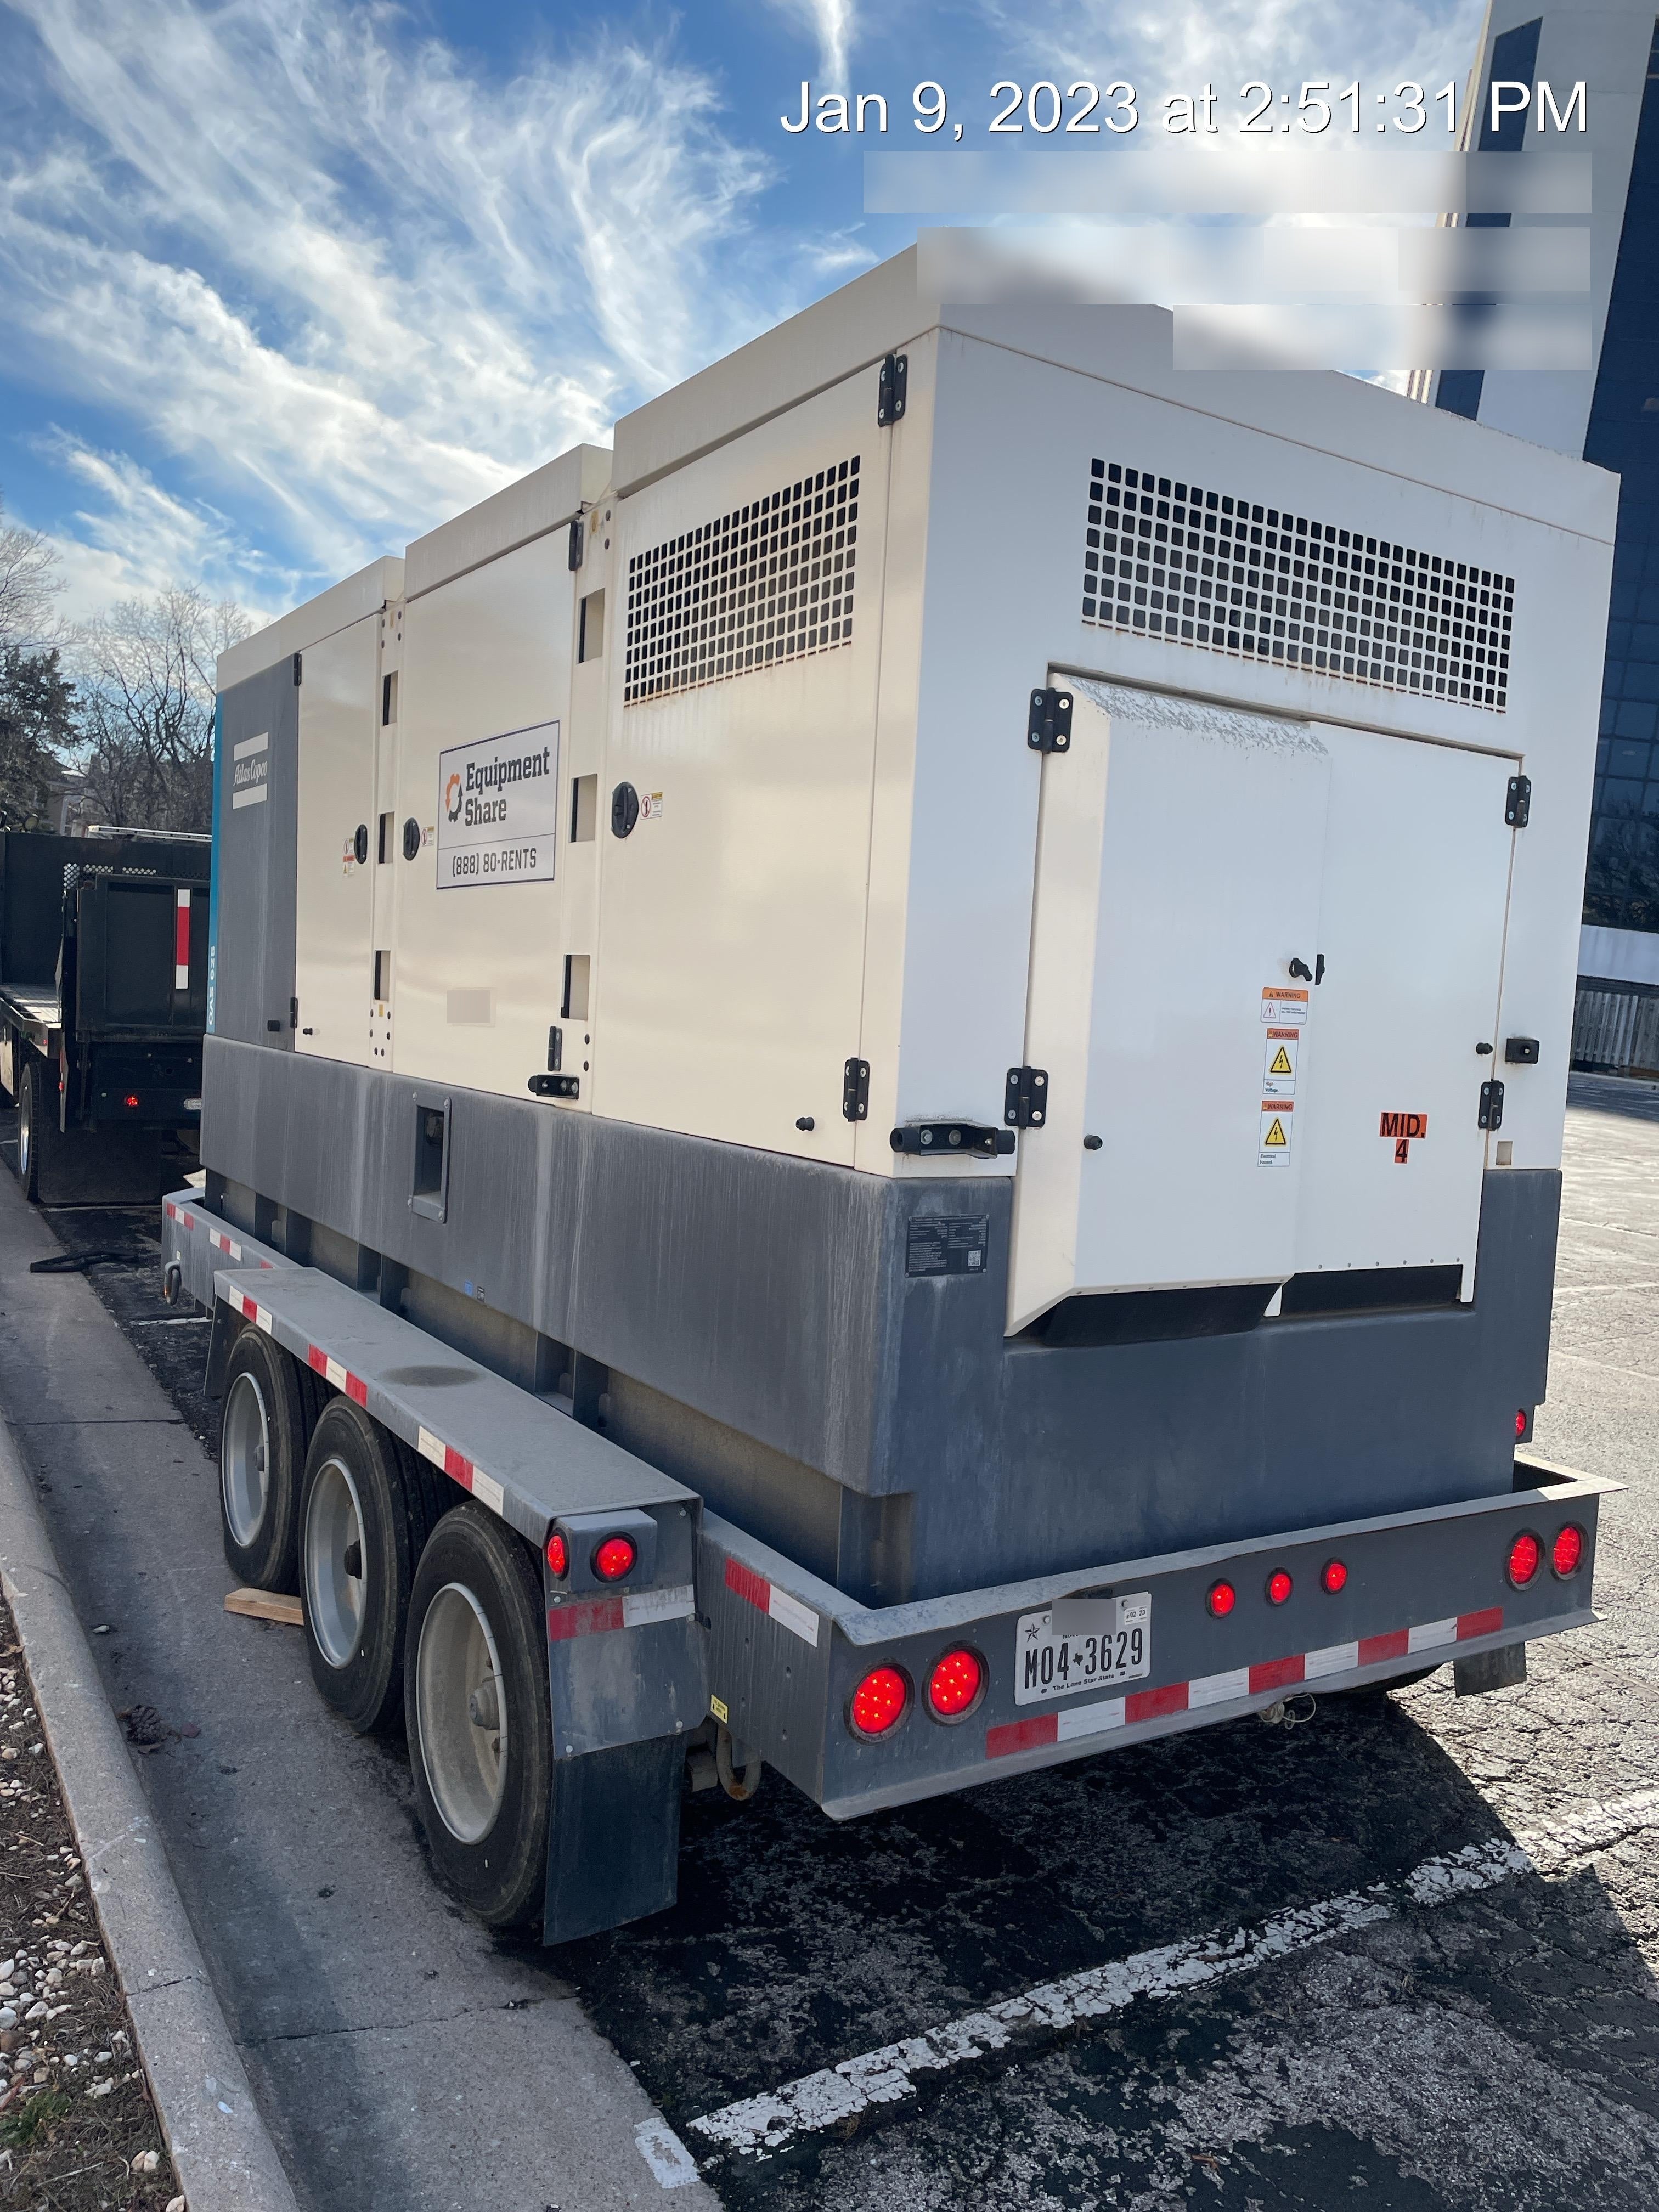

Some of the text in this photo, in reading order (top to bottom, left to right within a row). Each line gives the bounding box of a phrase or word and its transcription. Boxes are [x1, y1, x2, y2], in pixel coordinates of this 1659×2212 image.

[233, 759, 268, 786] Atlas Copco
[466, 747, 550, 795] Equipment
[465, 797, 507, 826] Share
[453, 848, 537, 877] (888) 80-RENTS
[1381, 1113, 1426, 1138] MID.
[1395, 1139, 1408, 1163] 4
